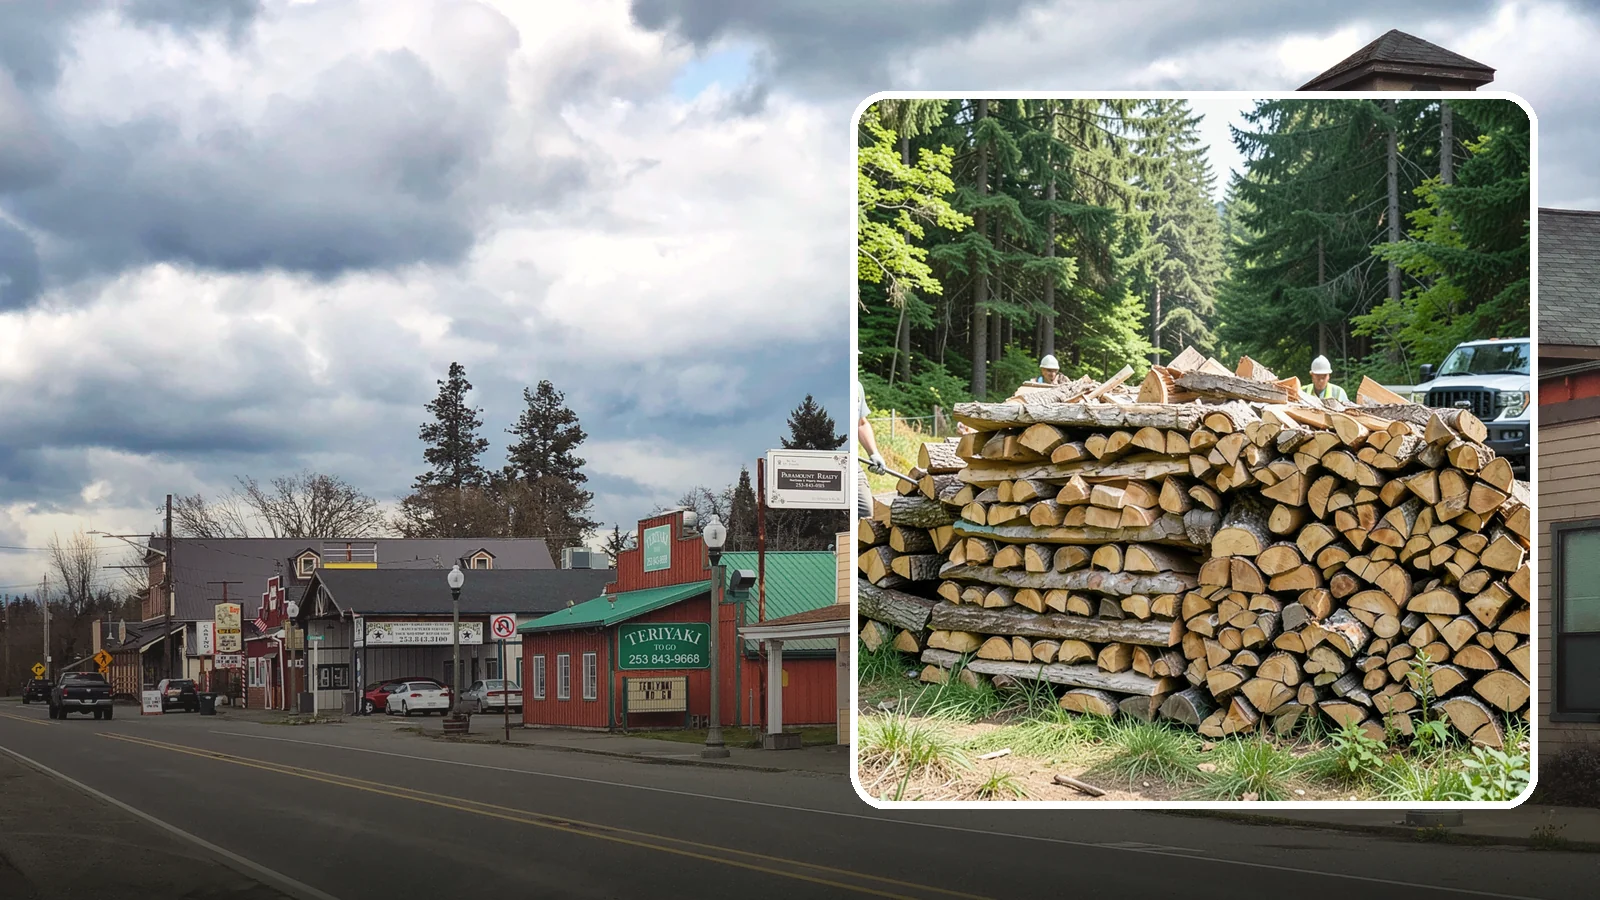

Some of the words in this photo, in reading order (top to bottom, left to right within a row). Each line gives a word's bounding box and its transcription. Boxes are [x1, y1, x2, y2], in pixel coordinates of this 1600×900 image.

[781, 471, 815, 479] PARAMOUNT
[817, 472, 838, 480] REALTY
[625, 627, 702, 646] TERIYAKI
[653, 643, 665, 651] TO
[665, 643, 677, 651] GO
[628, 654, 649, 664] 253
[651, 653, 700, 664] 843-9668
